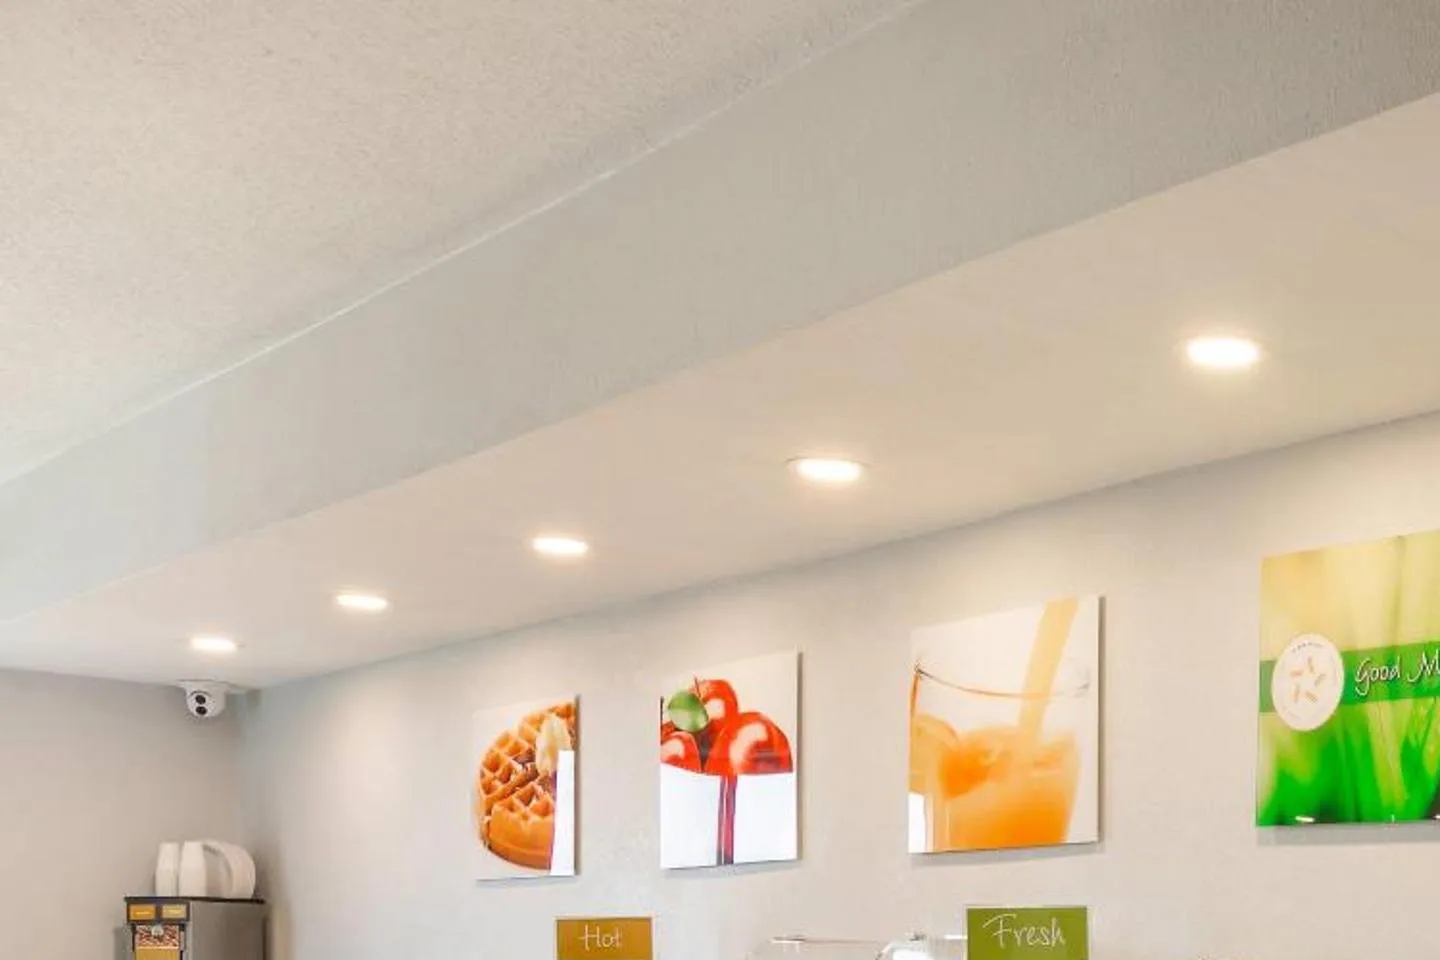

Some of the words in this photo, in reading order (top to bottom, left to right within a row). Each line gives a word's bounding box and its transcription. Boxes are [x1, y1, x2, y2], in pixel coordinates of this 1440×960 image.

[1355, 656, 1401, 696] Good
[578, 923, 622, 951] Hot
[982, 913, 1066, 949] Fresh
